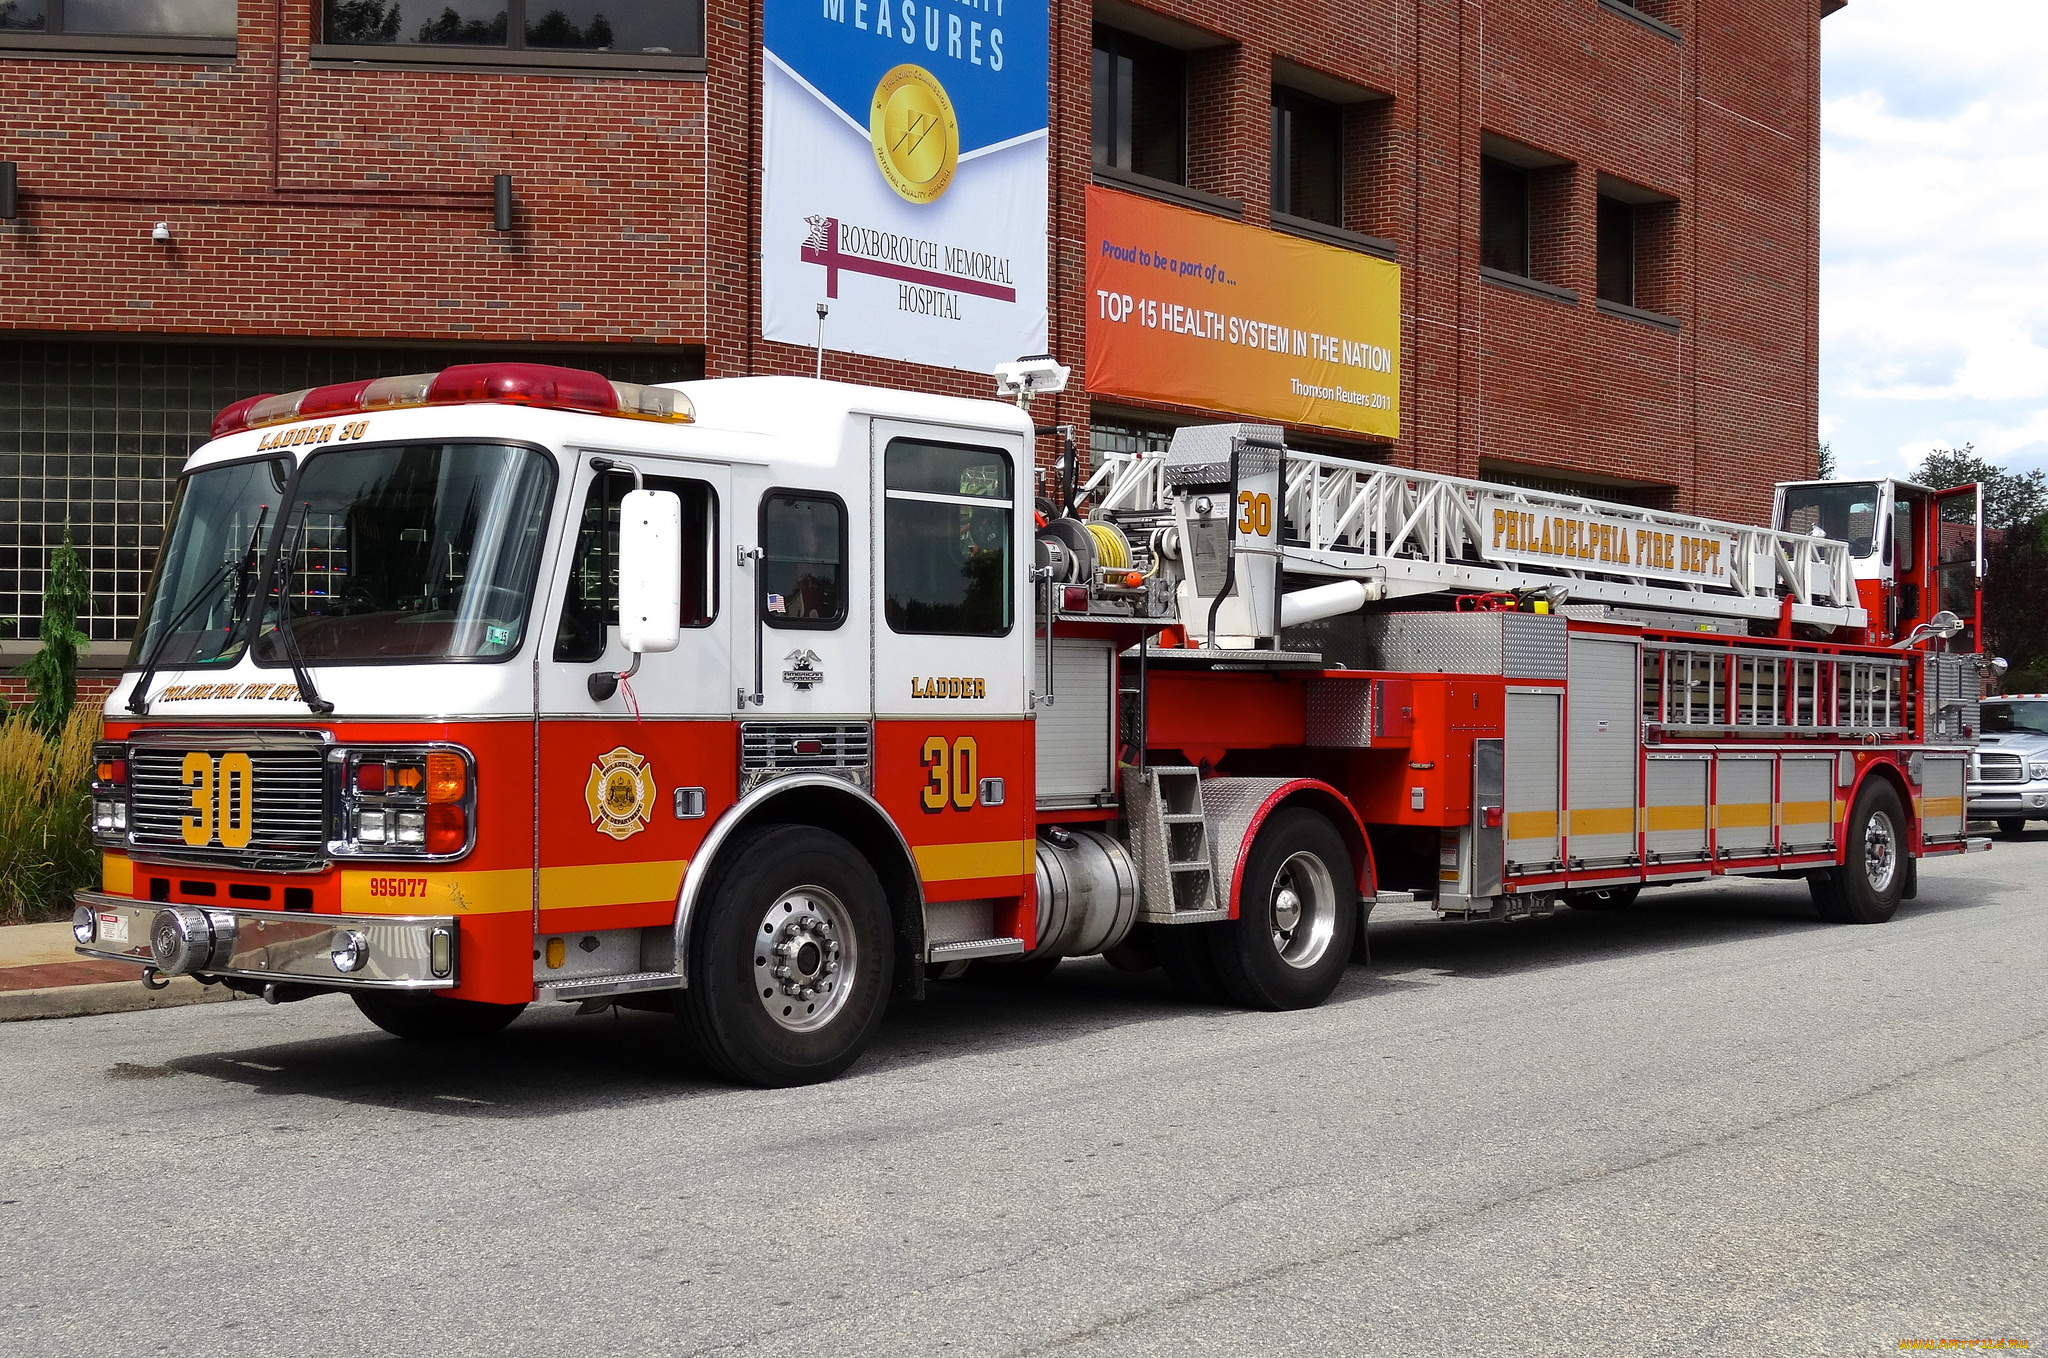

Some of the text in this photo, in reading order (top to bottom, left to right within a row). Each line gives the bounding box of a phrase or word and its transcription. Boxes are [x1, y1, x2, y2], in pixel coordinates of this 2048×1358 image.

[900, 184, 926, 198] QUALITY
[841, 223, 1013, 285] ROXBOROUGH MEMORIAL
[1101, 240, 1136, 263] Proud
[1138, 249, 1151, 267] to
[1153, 250, 1167, 270] be
[1170, 259, 1177, 272] a
[1179, 261, 1203, 278] part
[1204, 264, 1217, 284] of
[1218, 270, 1225, 282] a
[898, 284, 961, 321] HOSPITAL
[1097, 289, 1392, 374] TOP 15 HEALTH SYSTEM IN THE NATION
[1290, 378, 1392, 411] Thomson Reuters 2011
[256, 420, 370, 453] LADDER 30
[1238, 490, 1272, 537] 30
[1493, 508, 1724, 576] PHILADELPHIA FIRE DEPT.
[158, 683, 302, 703] PHILADELPHIA FIRE DEP
[911, 677, 986, 699] LADDER
[602, 761, 640, 777] PHILADELPHIA
[920, 736, 977, 814] 30
[182, 752, 252, 848] 30
[599, 803, 643, 825] FIRE DEPARTMENT
[370, 878, 428, 898] 995077
